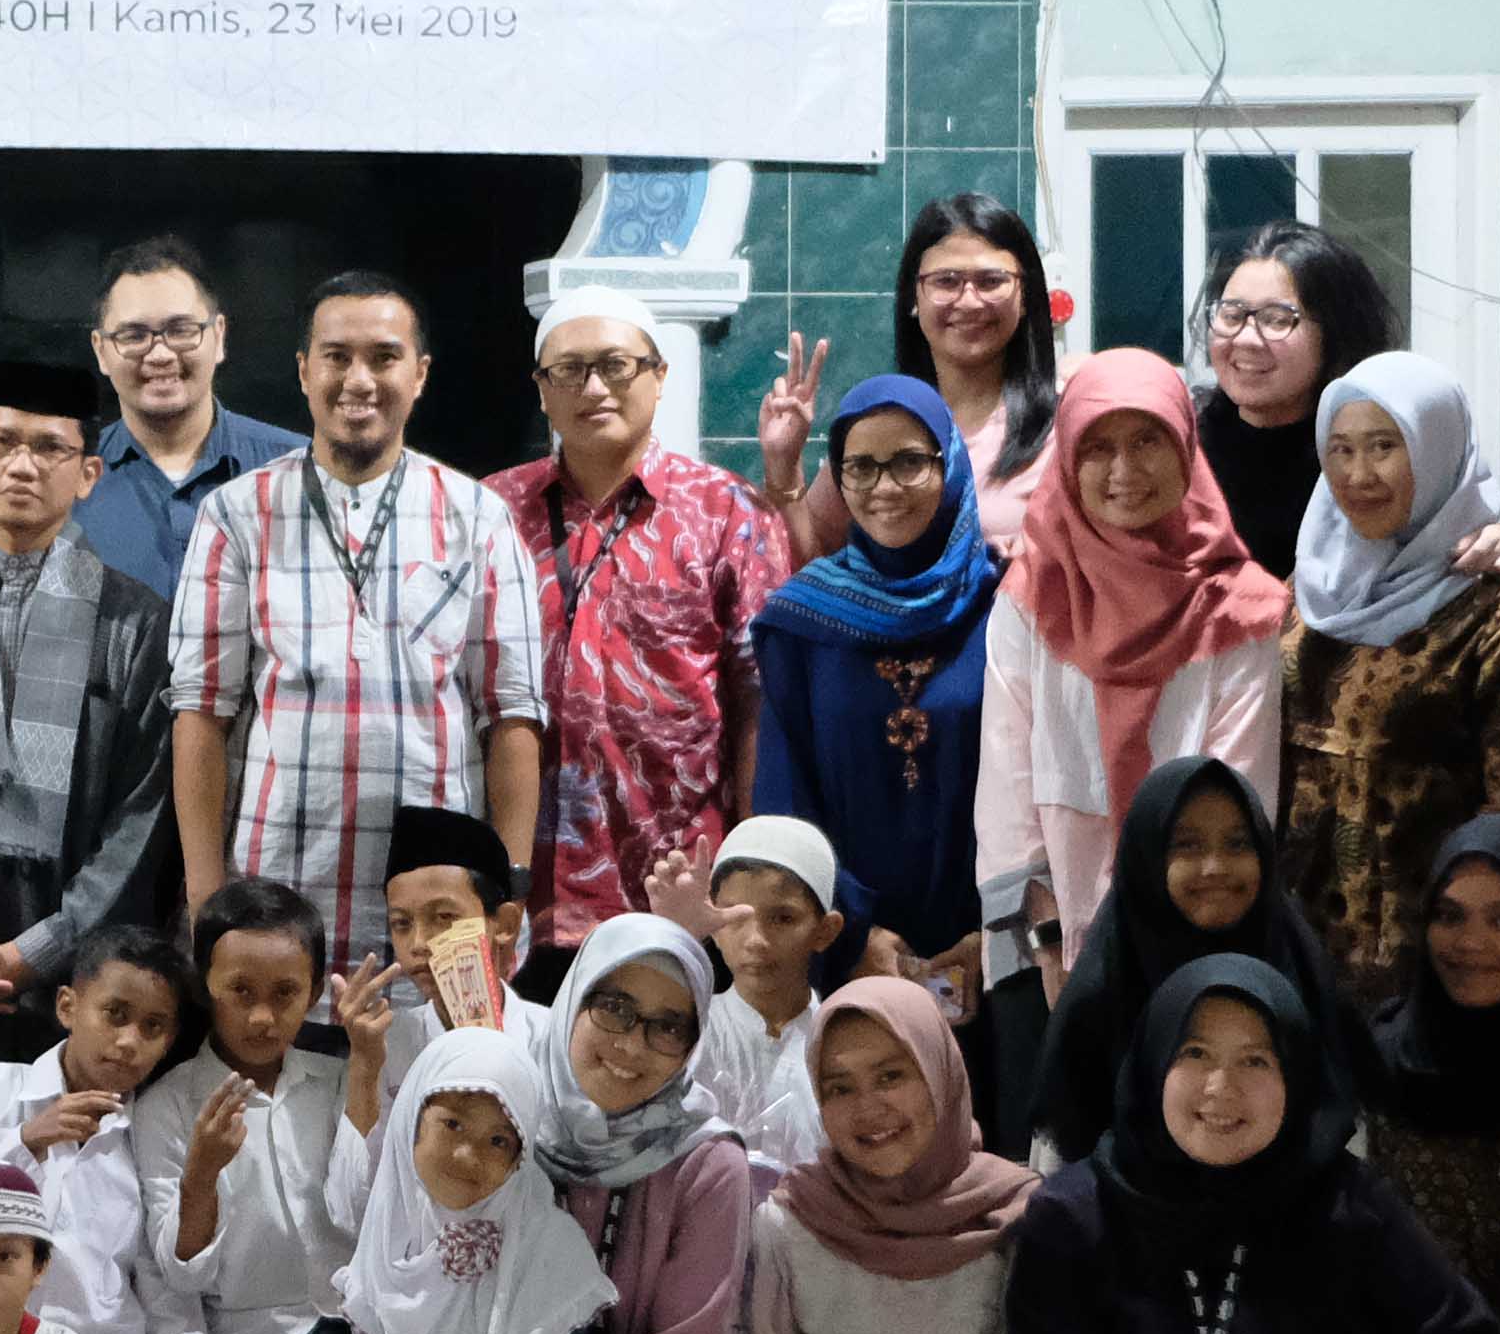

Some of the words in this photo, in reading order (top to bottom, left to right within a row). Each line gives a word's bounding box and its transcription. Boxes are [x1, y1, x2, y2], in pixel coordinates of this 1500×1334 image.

[114, 0, 251, 38] Kamis,
[267, 2, 317, 36] 23
[334, 2, 403, 37] Mei
[419, 5, 518, 39] 2019
